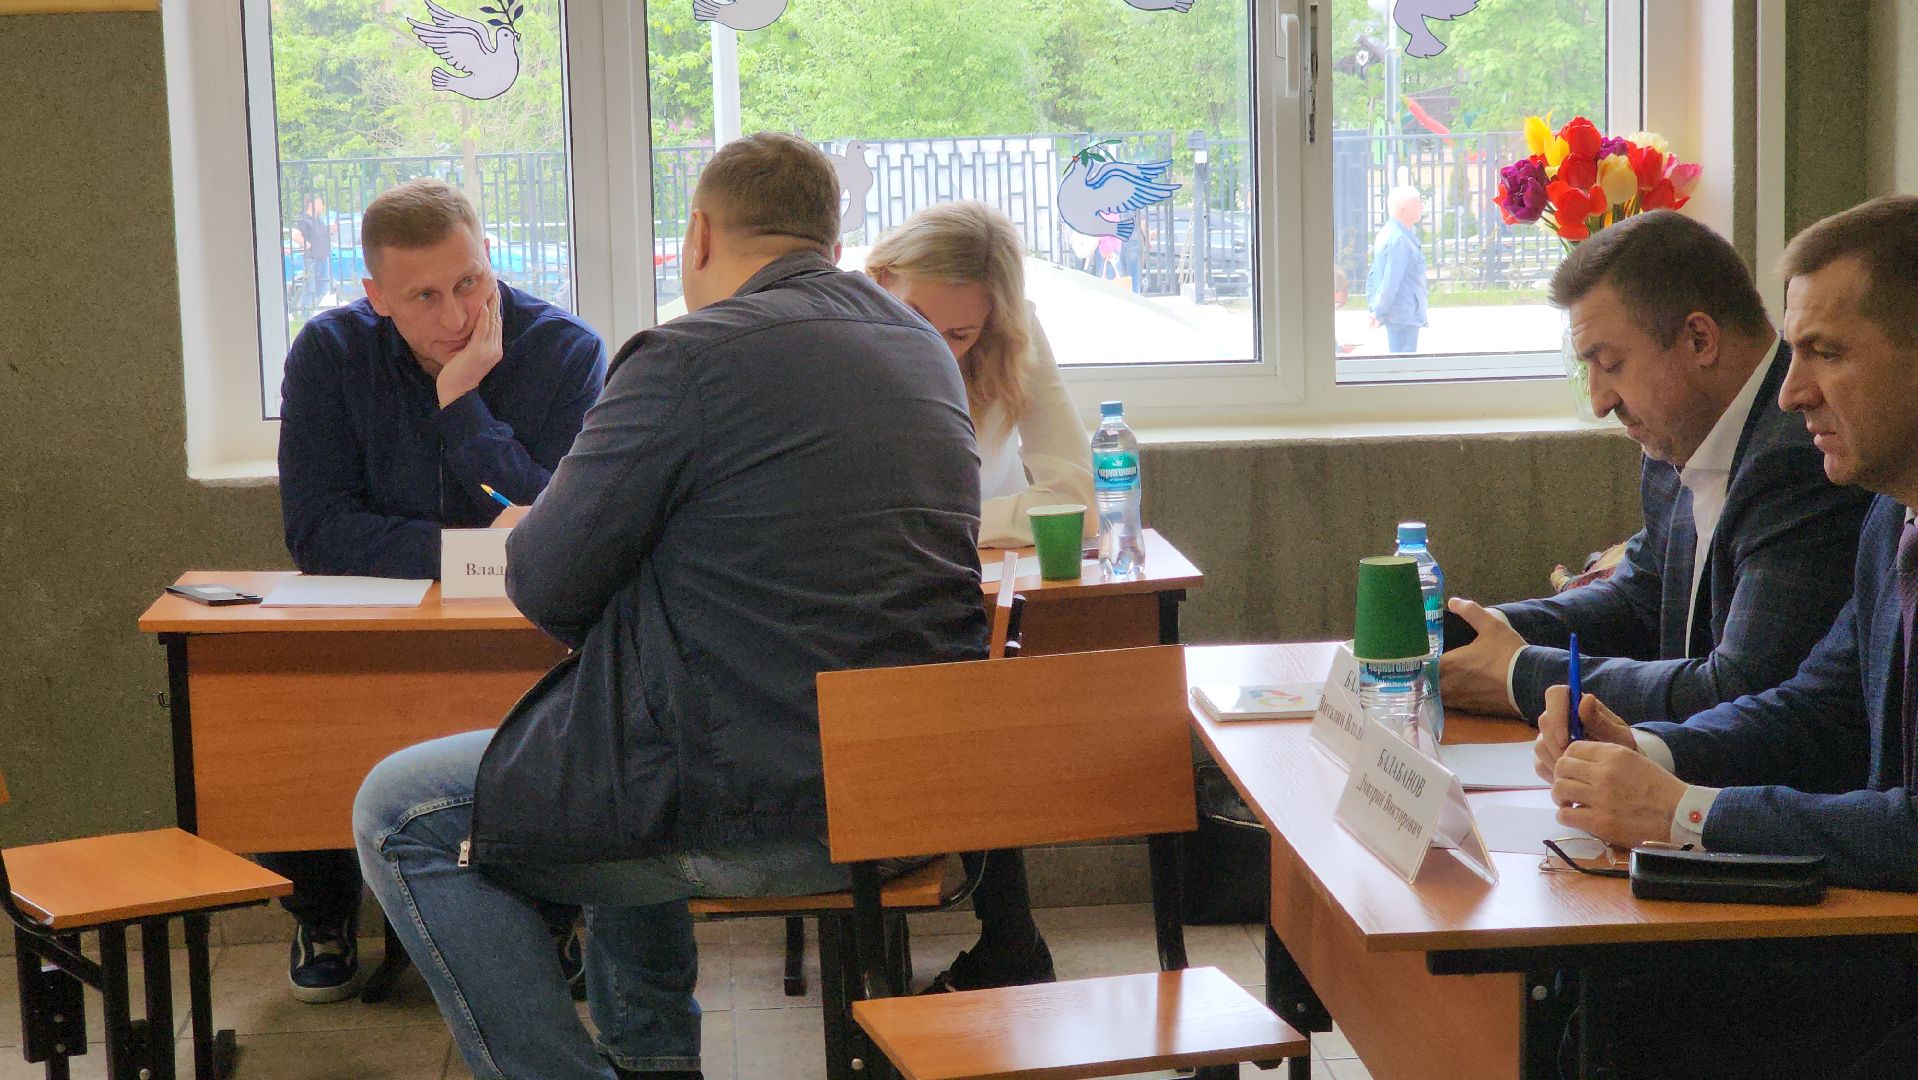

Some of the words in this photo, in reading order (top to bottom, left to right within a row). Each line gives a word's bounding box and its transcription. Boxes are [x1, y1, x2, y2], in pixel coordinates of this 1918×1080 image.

[1344, 669, 1360, 696] БА
[1377, 747, 1426, 798] БАЛАБАНОВ
[1356, 772, 1387, 808] Дмитрий
[1383, 793, 1424, 839] Викторович
